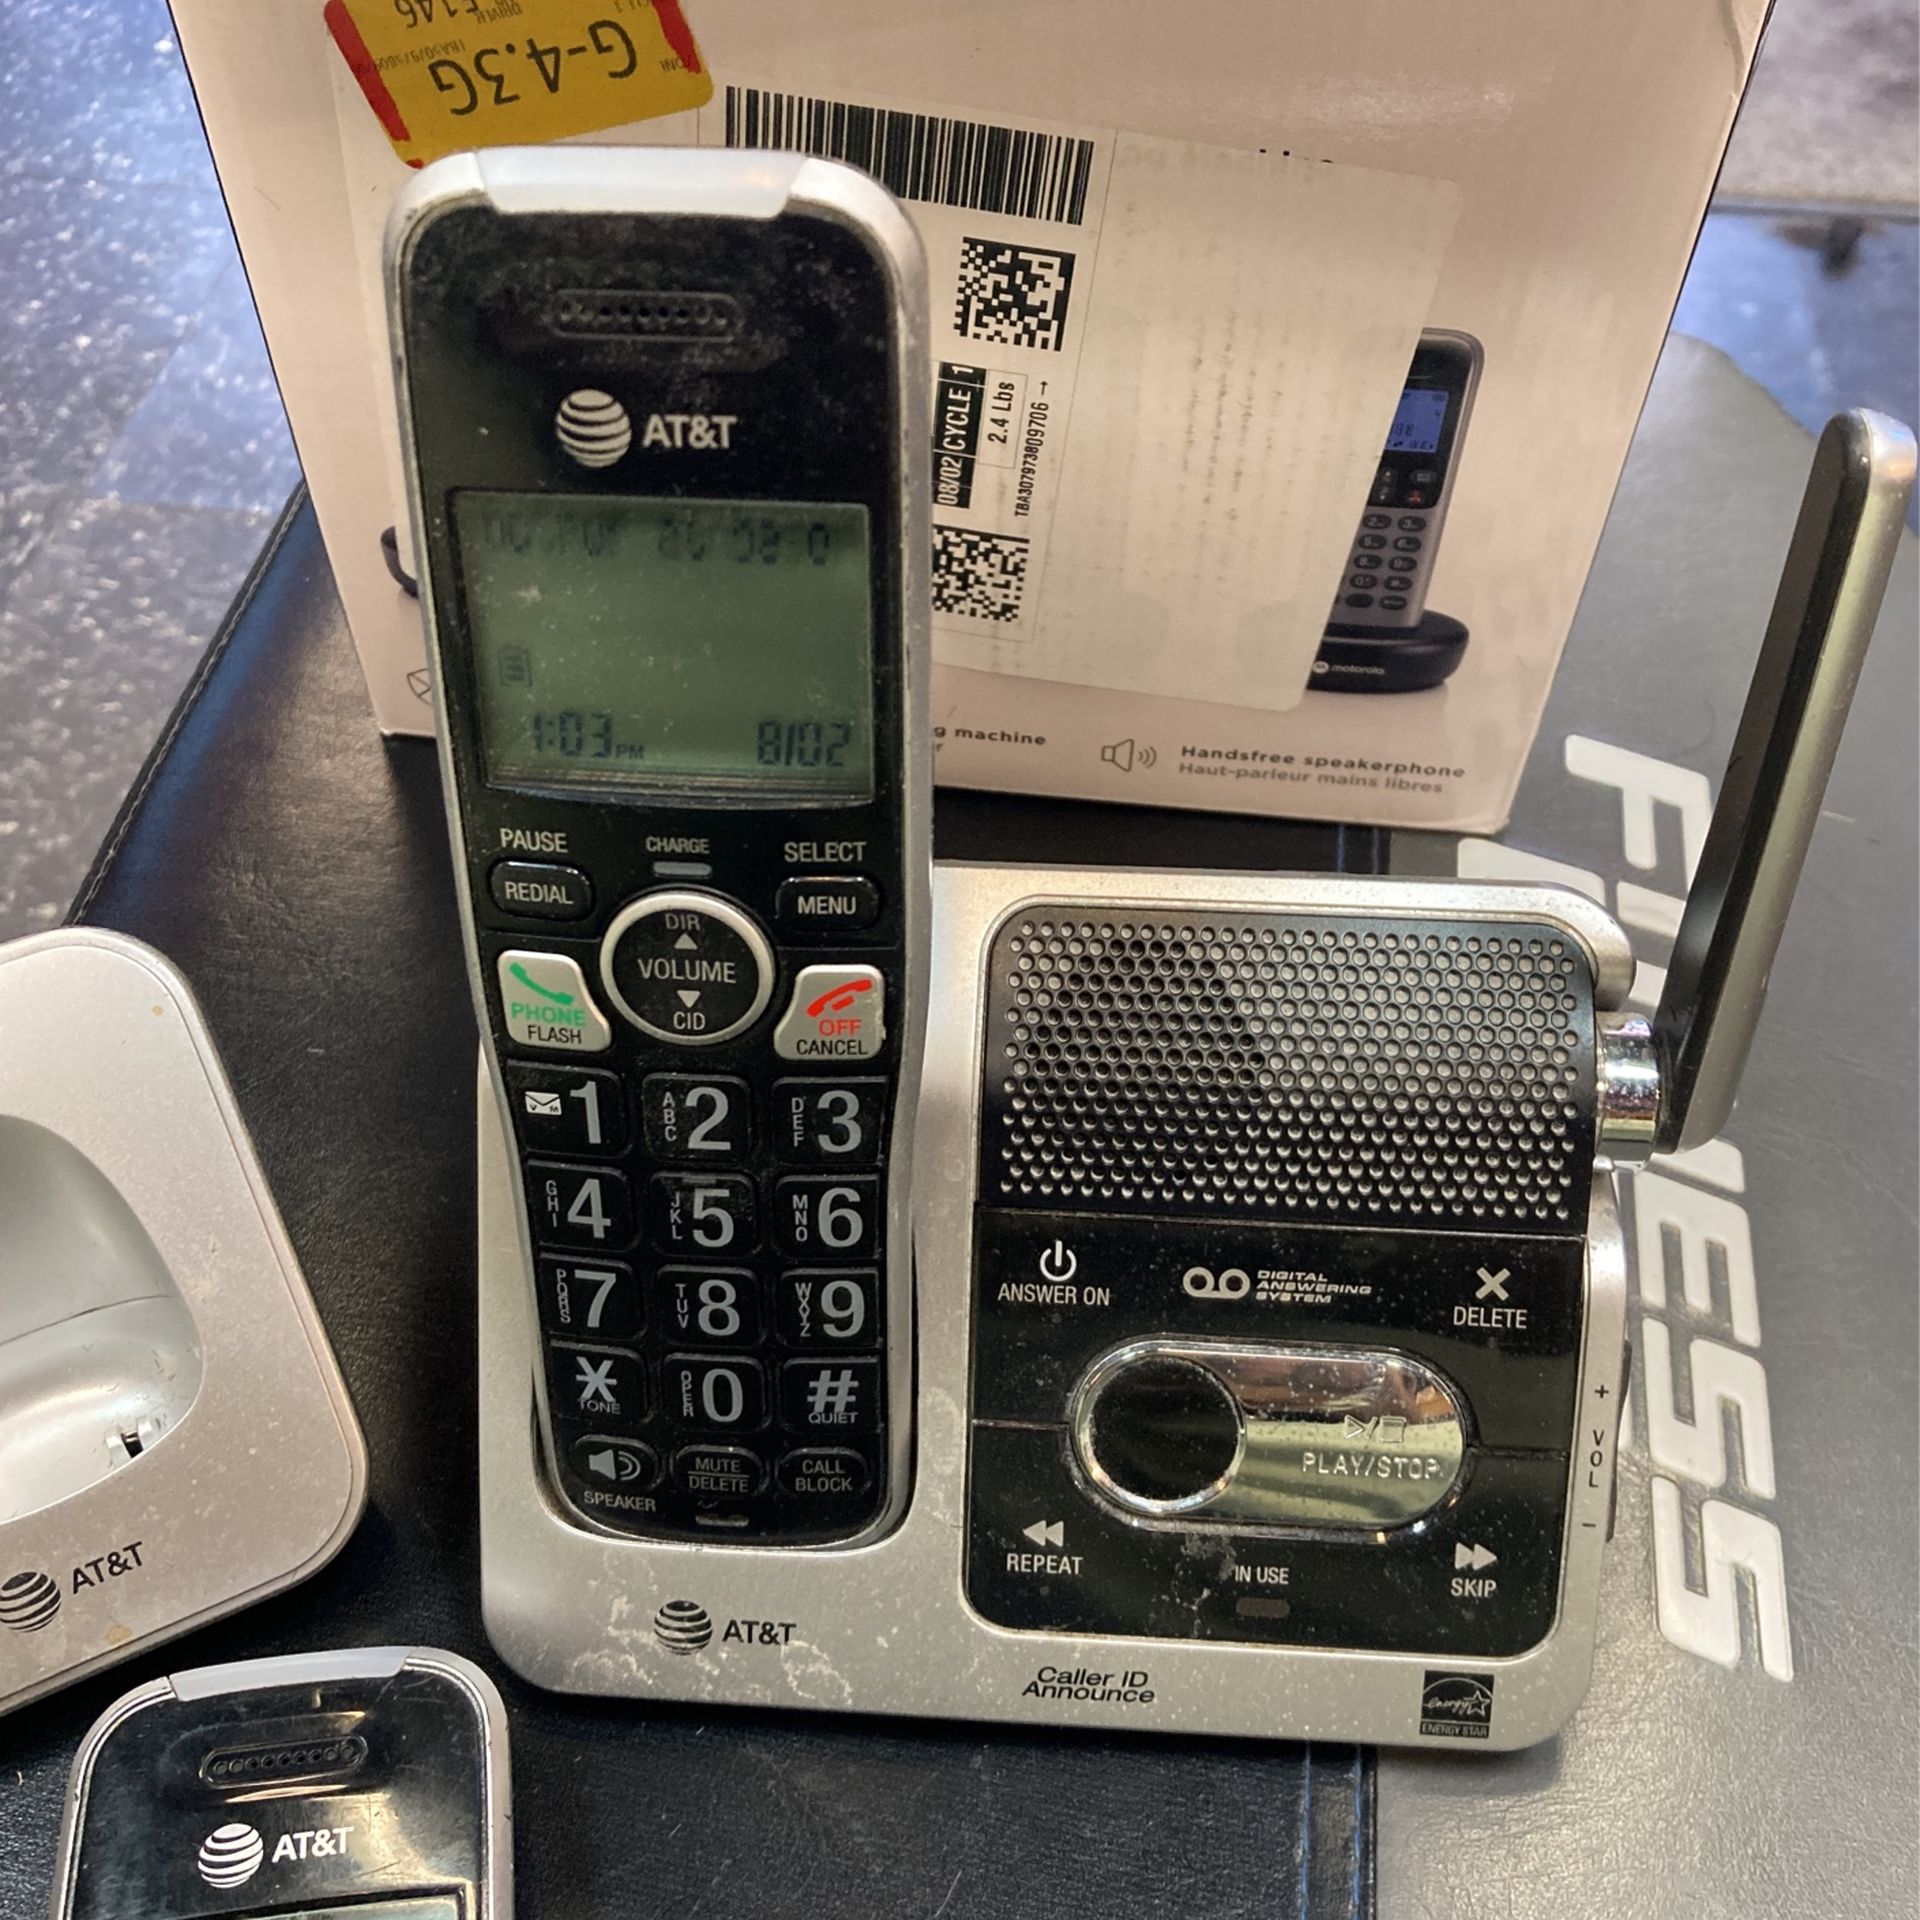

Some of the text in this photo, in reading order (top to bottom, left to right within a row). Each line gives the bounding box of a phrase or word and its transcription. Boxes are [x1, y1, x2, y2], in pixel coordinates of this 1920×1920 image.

[428, 19, 638, 116] G-4.3G
[988, 382, 1015, 444] 2.4 Lbs
[643, 415, 737, 449] AT&T
[1014, 402, 1049, 518] TBA307973809706
[937, 456, 963, 505] 08/02
[1332, 665, 1385, 675] motorola
[533, 713, 645, 759] 1:03 PM
[955, 728, 1047, 745] machine
[1181, 746, 1466, 778] Handsfree speakerphone
[1179, 763, 1443, 793] Haut-parleur mains libres
[500, 828, 568, 853] PAUSE
[646, 837, 710, 854] CHARGE
[784, 842, 867, 862] SELECT
[505, 882, 574, 905] REDIAL
[797, 896, 857, 915] MENU
[665, 913, 700, 930] DIR
[637, 958, 737, 983] VOLUME
[510, 1003, 585, 1027] PHONE
[673, 1011, 706, 1030] CID
[528, 1025, 582, 1044] FLASH
[818, 1019, 861, 1036] OFF
[796, 1039, 868, 1055] CANCEL
[570, 1080, 601, 1144] 1
[685, 1087, 731, 1150] 2
[817, 1090, 862, 1153] 3
[567, 1179, 611, 1239] 4
[692, 1188, 734, 1247] 5
[818, 1188, 863, 1247] 6
[1256, 1281, 1372, 1294] ANSWERING
[1257, 1270, 1328, 1282] DIGITAL
[574, 1269, 616, 1328] 7
[997, 1283, 1110, 1307] ANSWER ON
[1255, 1292, 1332, 1303] SYSTEM
[698, 1279, 740, 1336] 8
[820, 1280, 865, 1337] 9
[1454, 1306, 1528, 1330] DELETE
[579, 1398, 621, 1415] TONE
[702, 1368, 743, 1422] 0
[808, 1412, 858, 1425] QUIET
[695, 1458, 741, 1474] MUTE
[802, 1460, 845, 1475] CALL
[1302, 1452, 1440, 1479] PLAY/STOP
[688, 1476, 749, 1493] DELETE
[795, 1477, 852, 1493] BLOCK
[583, 1490, 656, 1512] SPEAKER
[71, 1541, 145, 1594] AT&T
[1006, 1553, 1083, 1576] REPEAT
[1234, 1565, 1289, 1586] IN USE
[1450, 1578, 1498, 1598] SKIP
[722, 1619, 797, 1645] AT&T
[1037, 1666, 1149, 1688] Caller ID
[1022, 1680, 1155, 1703] Announce
[1422, 1723, 1487, 1736] ENERGY STAR
[272, 1827, 354, 1864] AT&T
